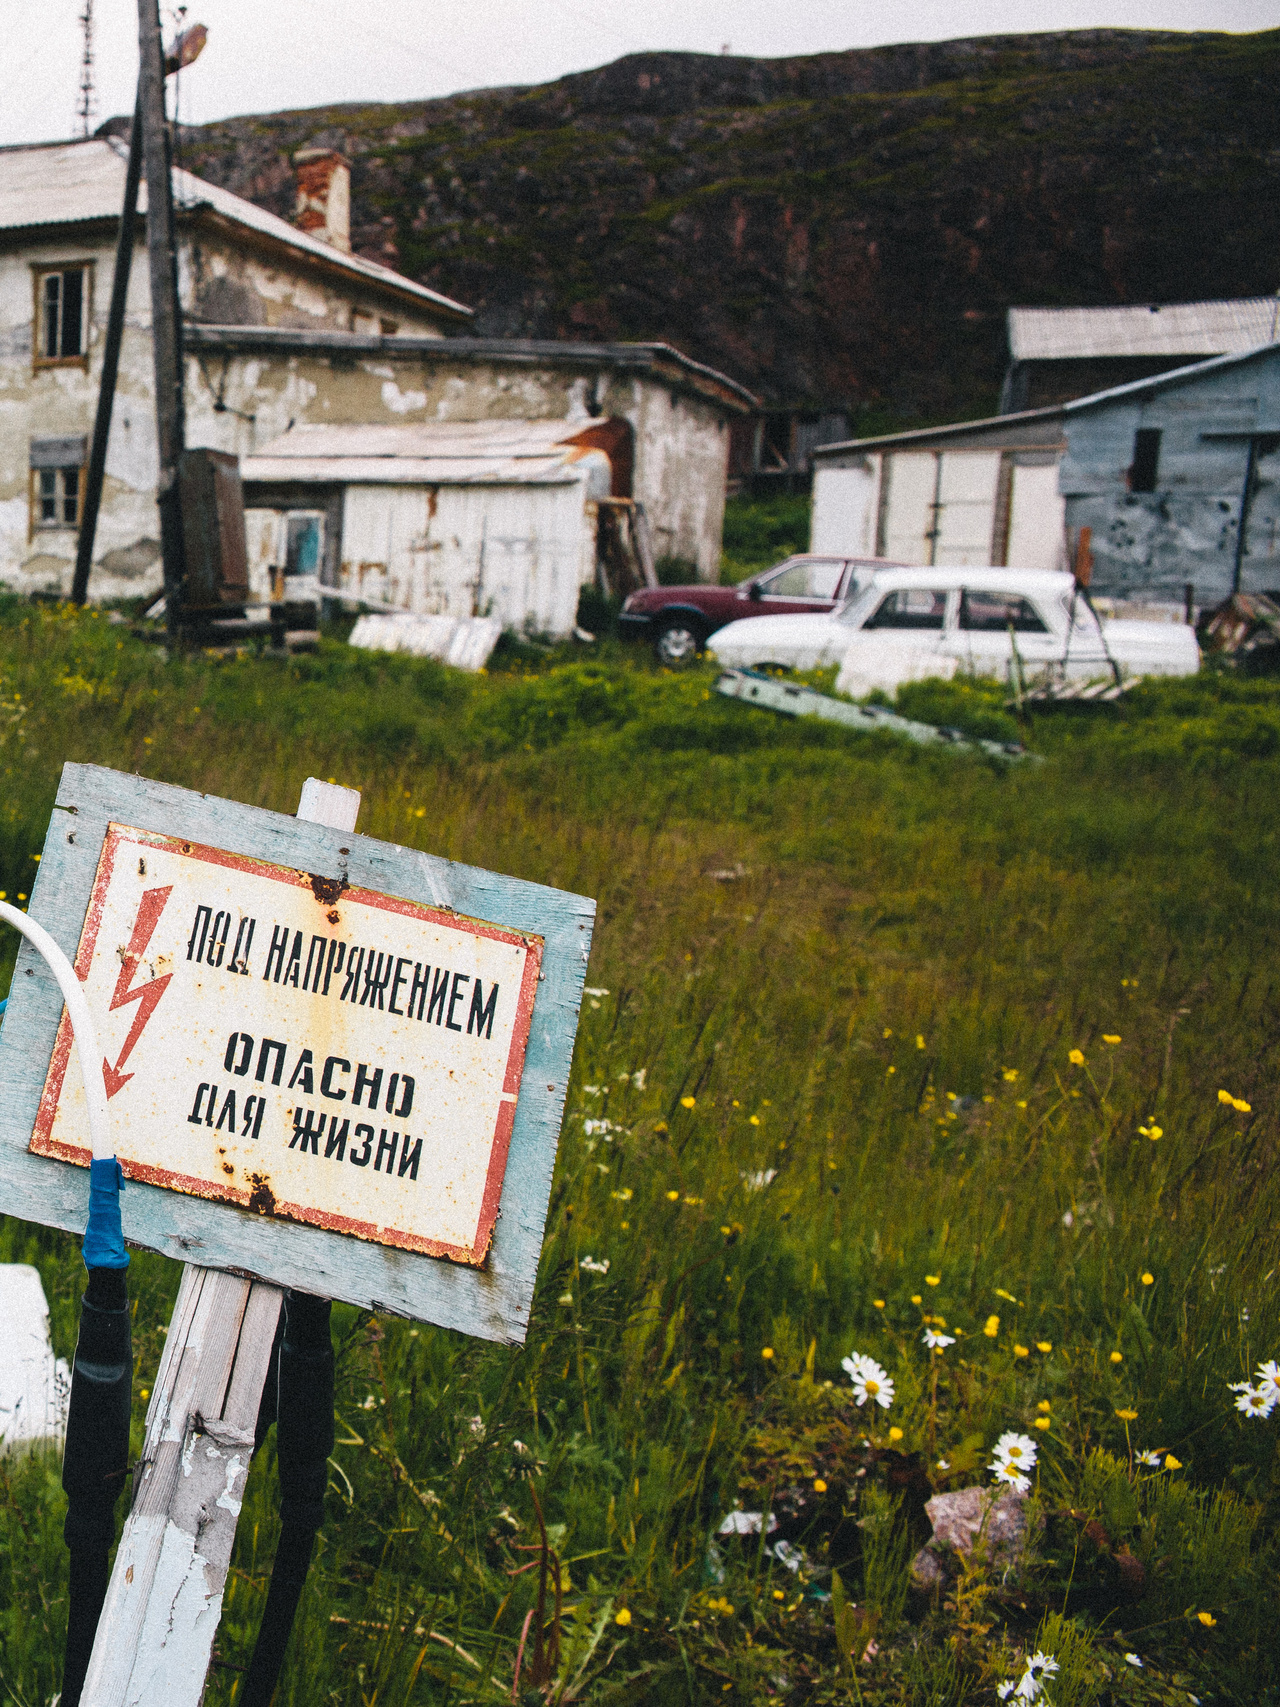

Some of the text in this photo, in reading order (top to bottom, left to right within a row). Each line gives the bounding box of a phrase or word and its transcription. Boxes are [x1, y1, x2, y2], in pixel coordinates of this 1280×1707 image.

[186, 904, 500, 1040] ПОД НАПРЯЖЕНИЕМ
[223, 1031, 416, 1119] ОПАСНО
[187, 1082, 424, 1182] ДЛЯ ЖИЗНИ
